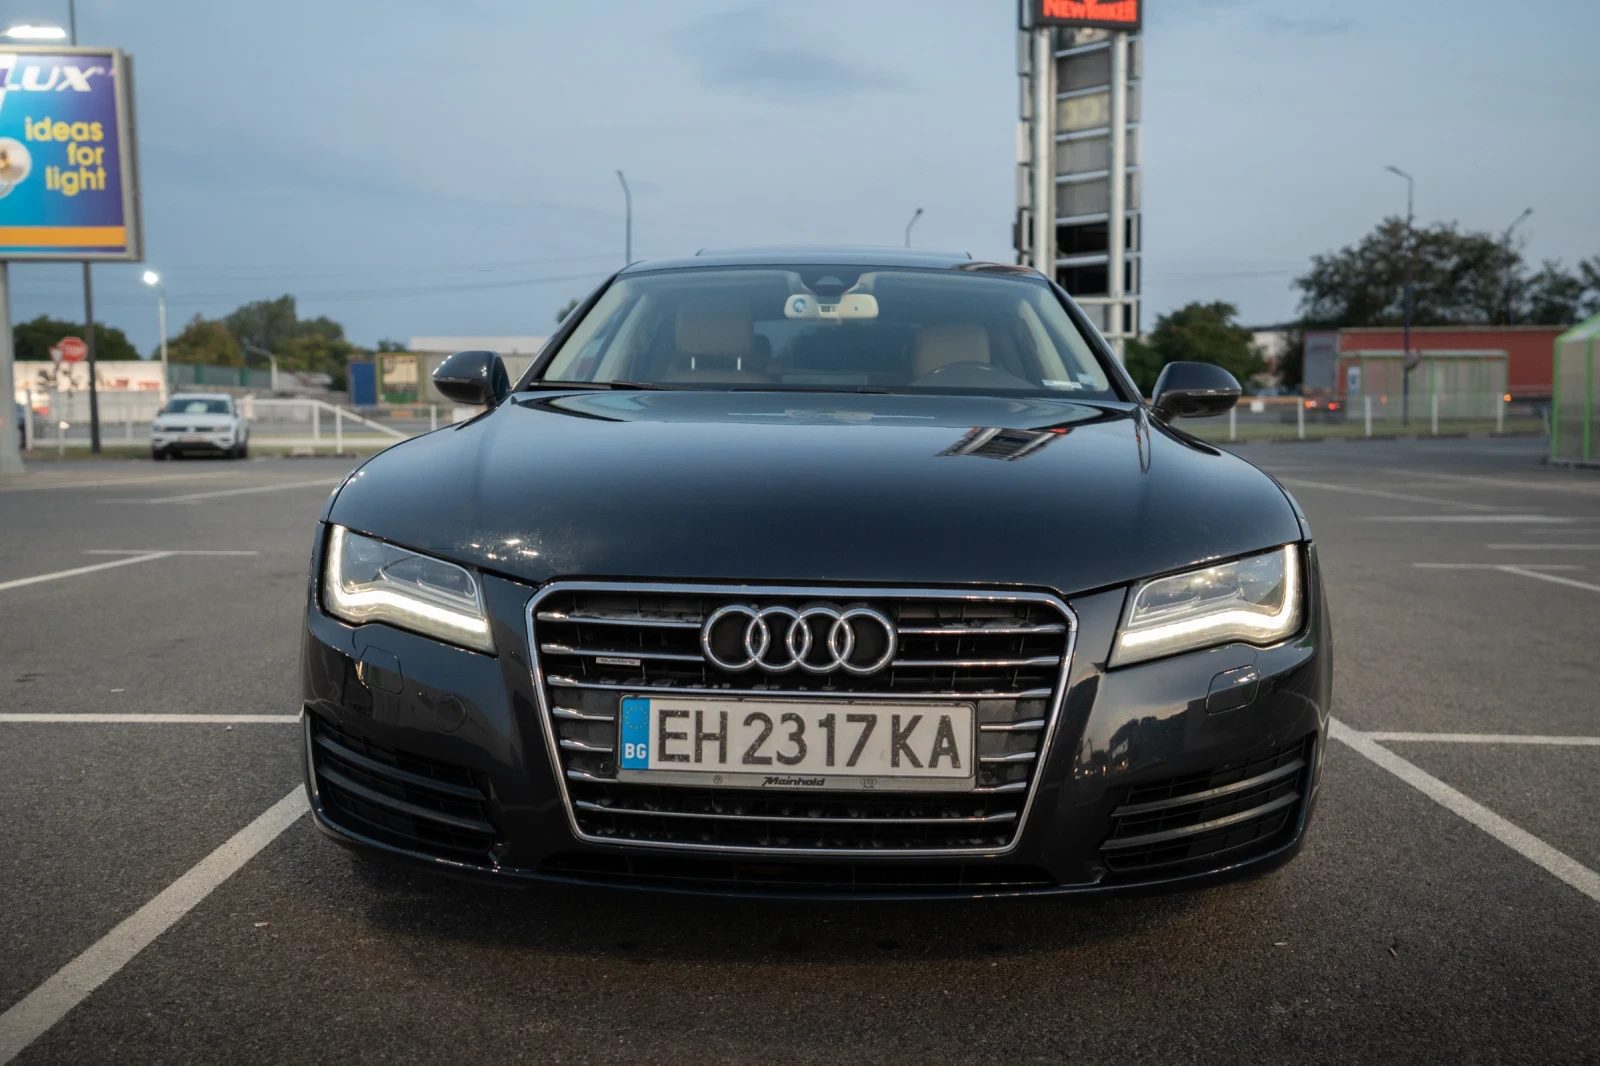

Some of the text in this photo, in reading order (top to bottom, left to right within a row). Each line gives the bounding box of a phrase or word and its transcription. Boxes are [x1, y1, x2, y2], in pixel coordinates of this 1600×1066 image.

[25, 116, 104, 141] ideas
[67, 142, 104, 166] for
[45, 166, 106, 196] light
[600, 658, 636, 666] quattro
[658, 709, 961, 768] EH 2317 KA
[624, 743, 647, 759] BG
